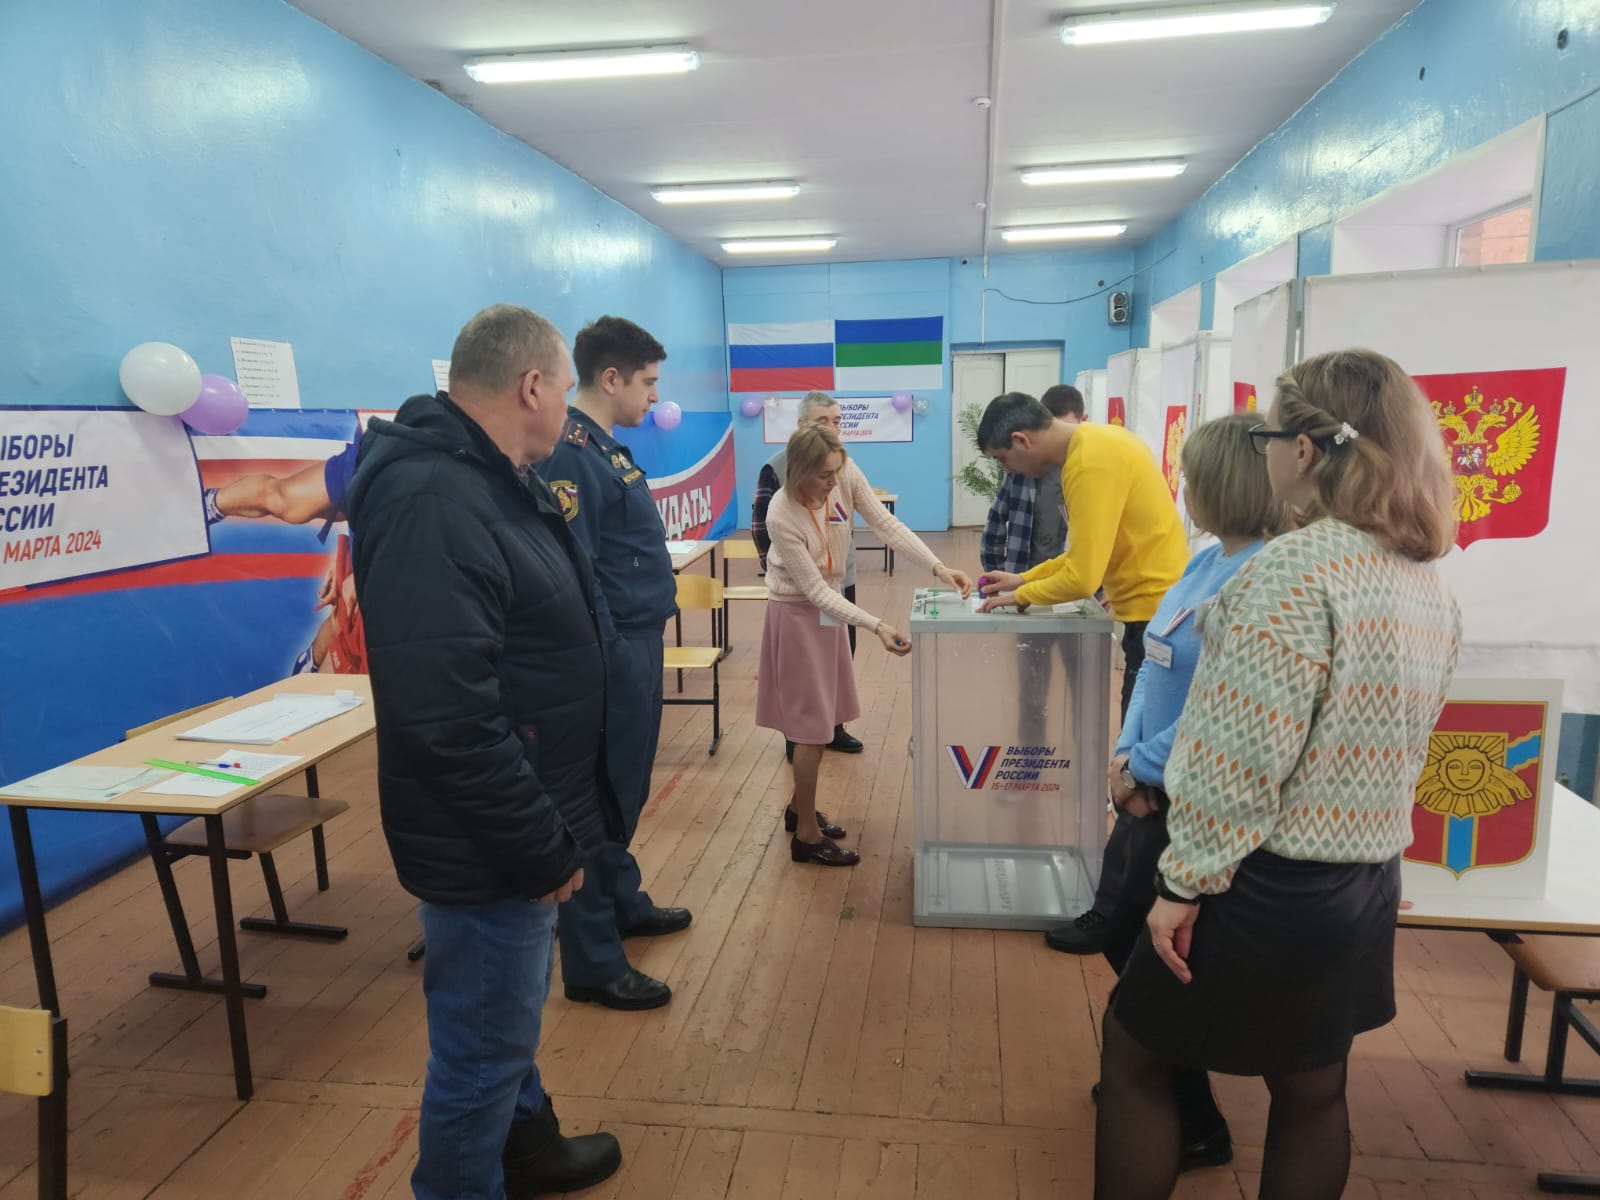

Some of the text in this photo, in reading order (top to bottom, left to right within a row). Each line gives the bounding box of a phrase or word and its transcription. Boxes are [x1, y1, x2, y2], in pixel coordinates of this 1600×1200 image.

[3, 529, 102, 564] МАРТА 2024
[1006, 746, 1056, 756] ВЫБОРЫ
[1000, 758, 1071, 769] ПРЕЗИДЕНТА
[995, 770, 1040, 780] РОССИИ
[1013, 782, 1040, 791] МАРТА
[1040, 783, 1060, 791] 2024
